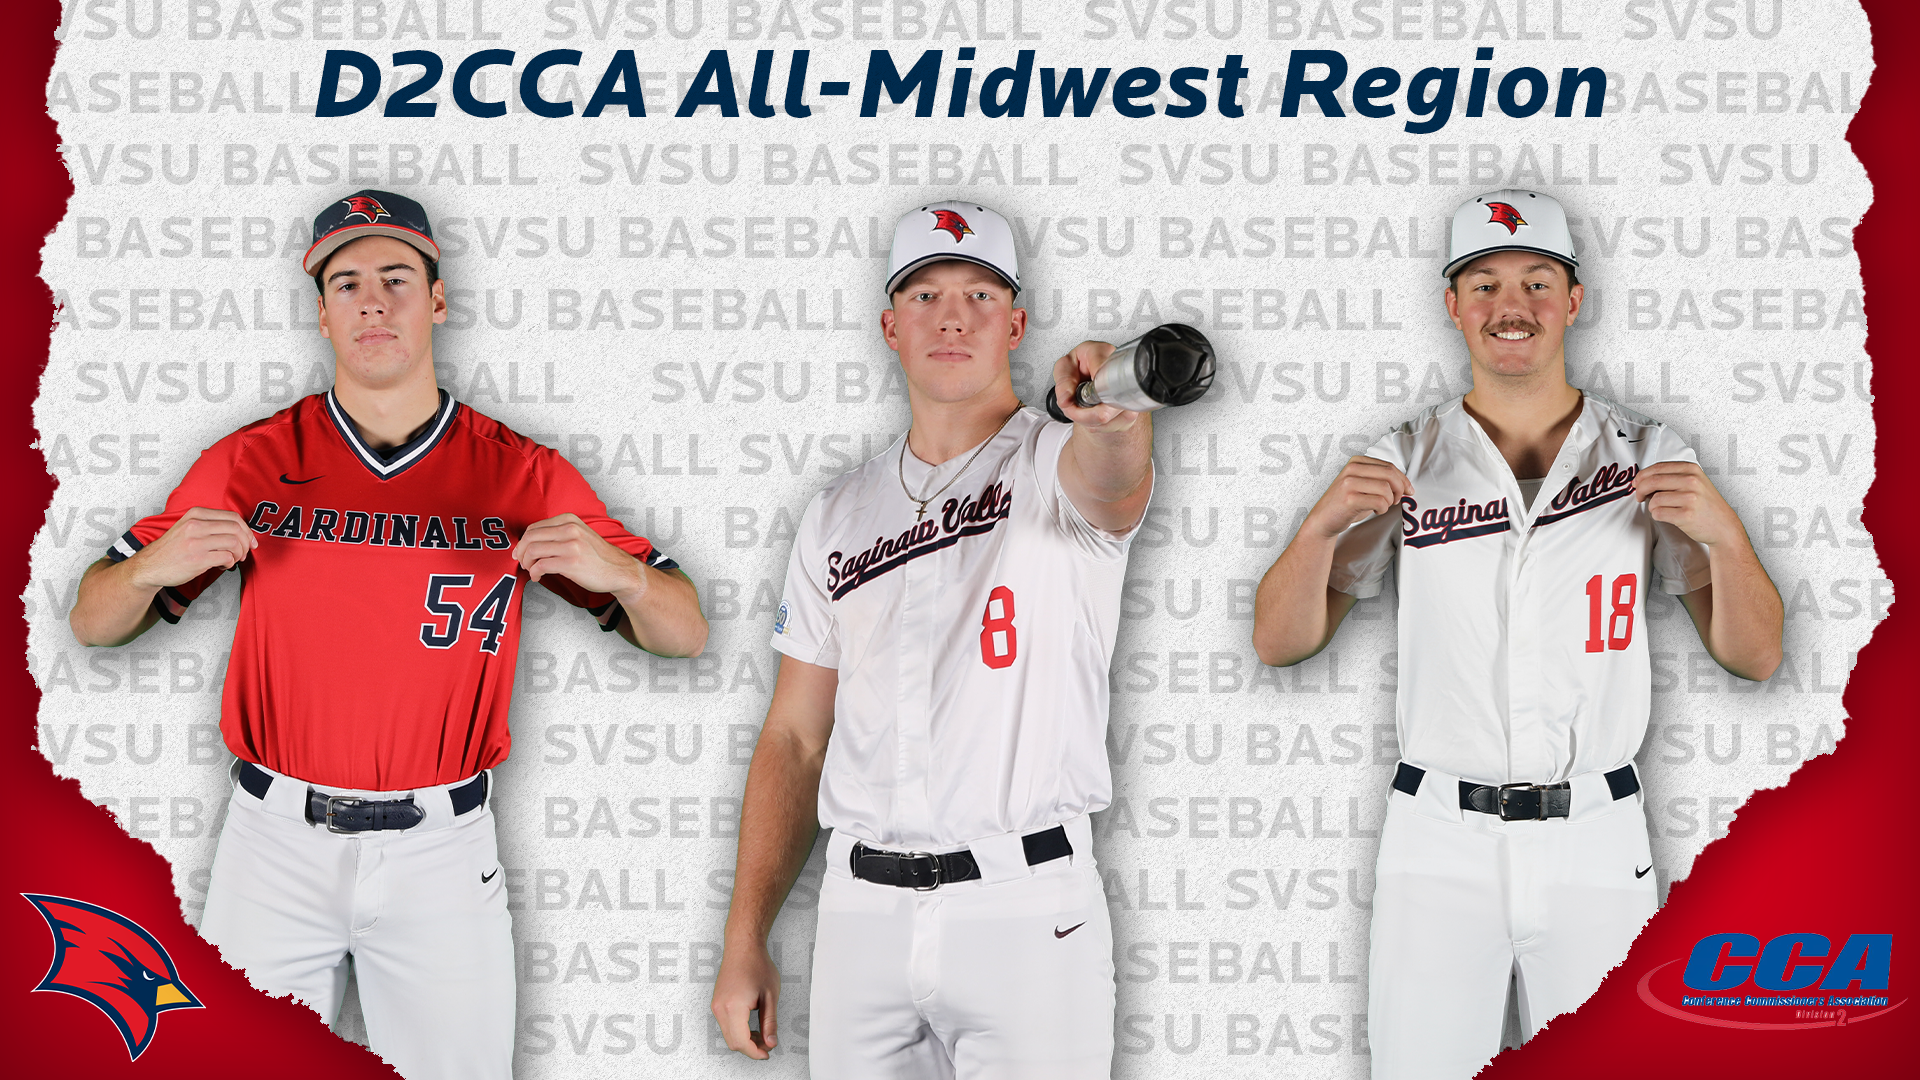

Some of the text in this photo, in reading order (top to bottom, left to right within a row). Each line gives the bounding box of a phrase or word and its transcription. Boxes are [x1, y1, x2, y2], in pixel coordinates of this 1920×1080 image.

[249, 500, 512, 550] CARDINALS
[827, 518, 939, 592] Saginaw
[419, 573, 517, 656] 54
[980, 584, 1017, 670] 8
[1585, 573, 1638, 653] 18
